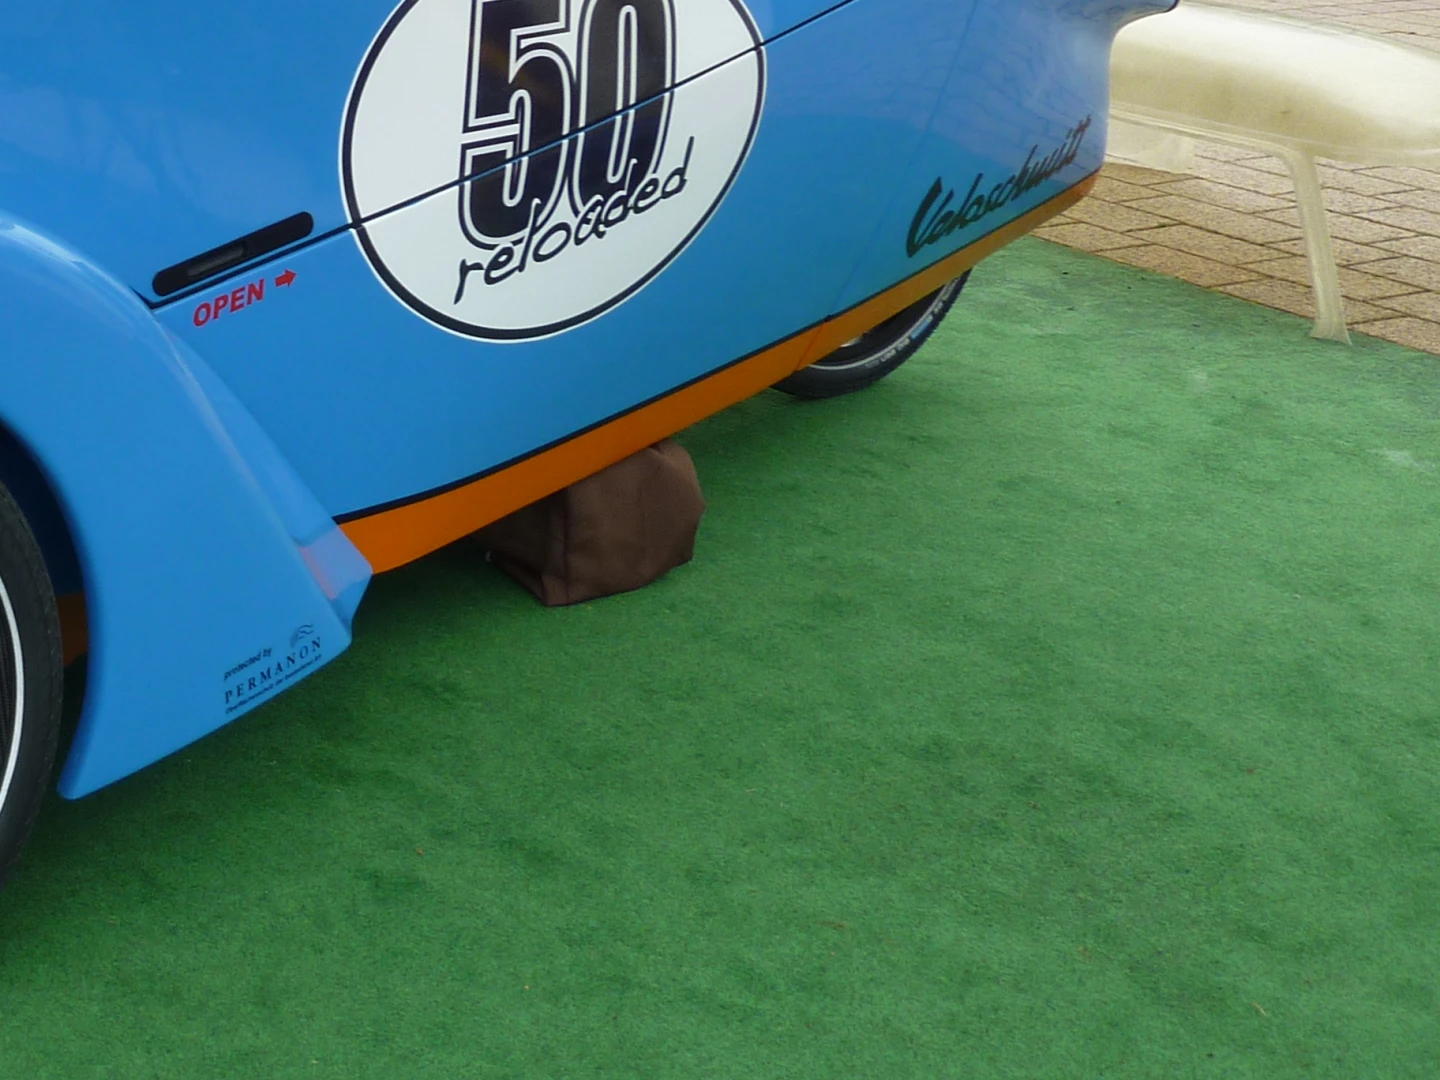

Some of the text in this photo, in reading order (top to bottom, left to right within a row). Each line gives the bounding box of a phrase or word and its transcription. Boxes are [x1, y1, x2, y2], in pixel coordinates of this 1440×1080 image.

[453, 135, 695, 305] reloaded
[193, 278, 266, 328] OPEN
[224, 636, 322, 704] PERMANON
